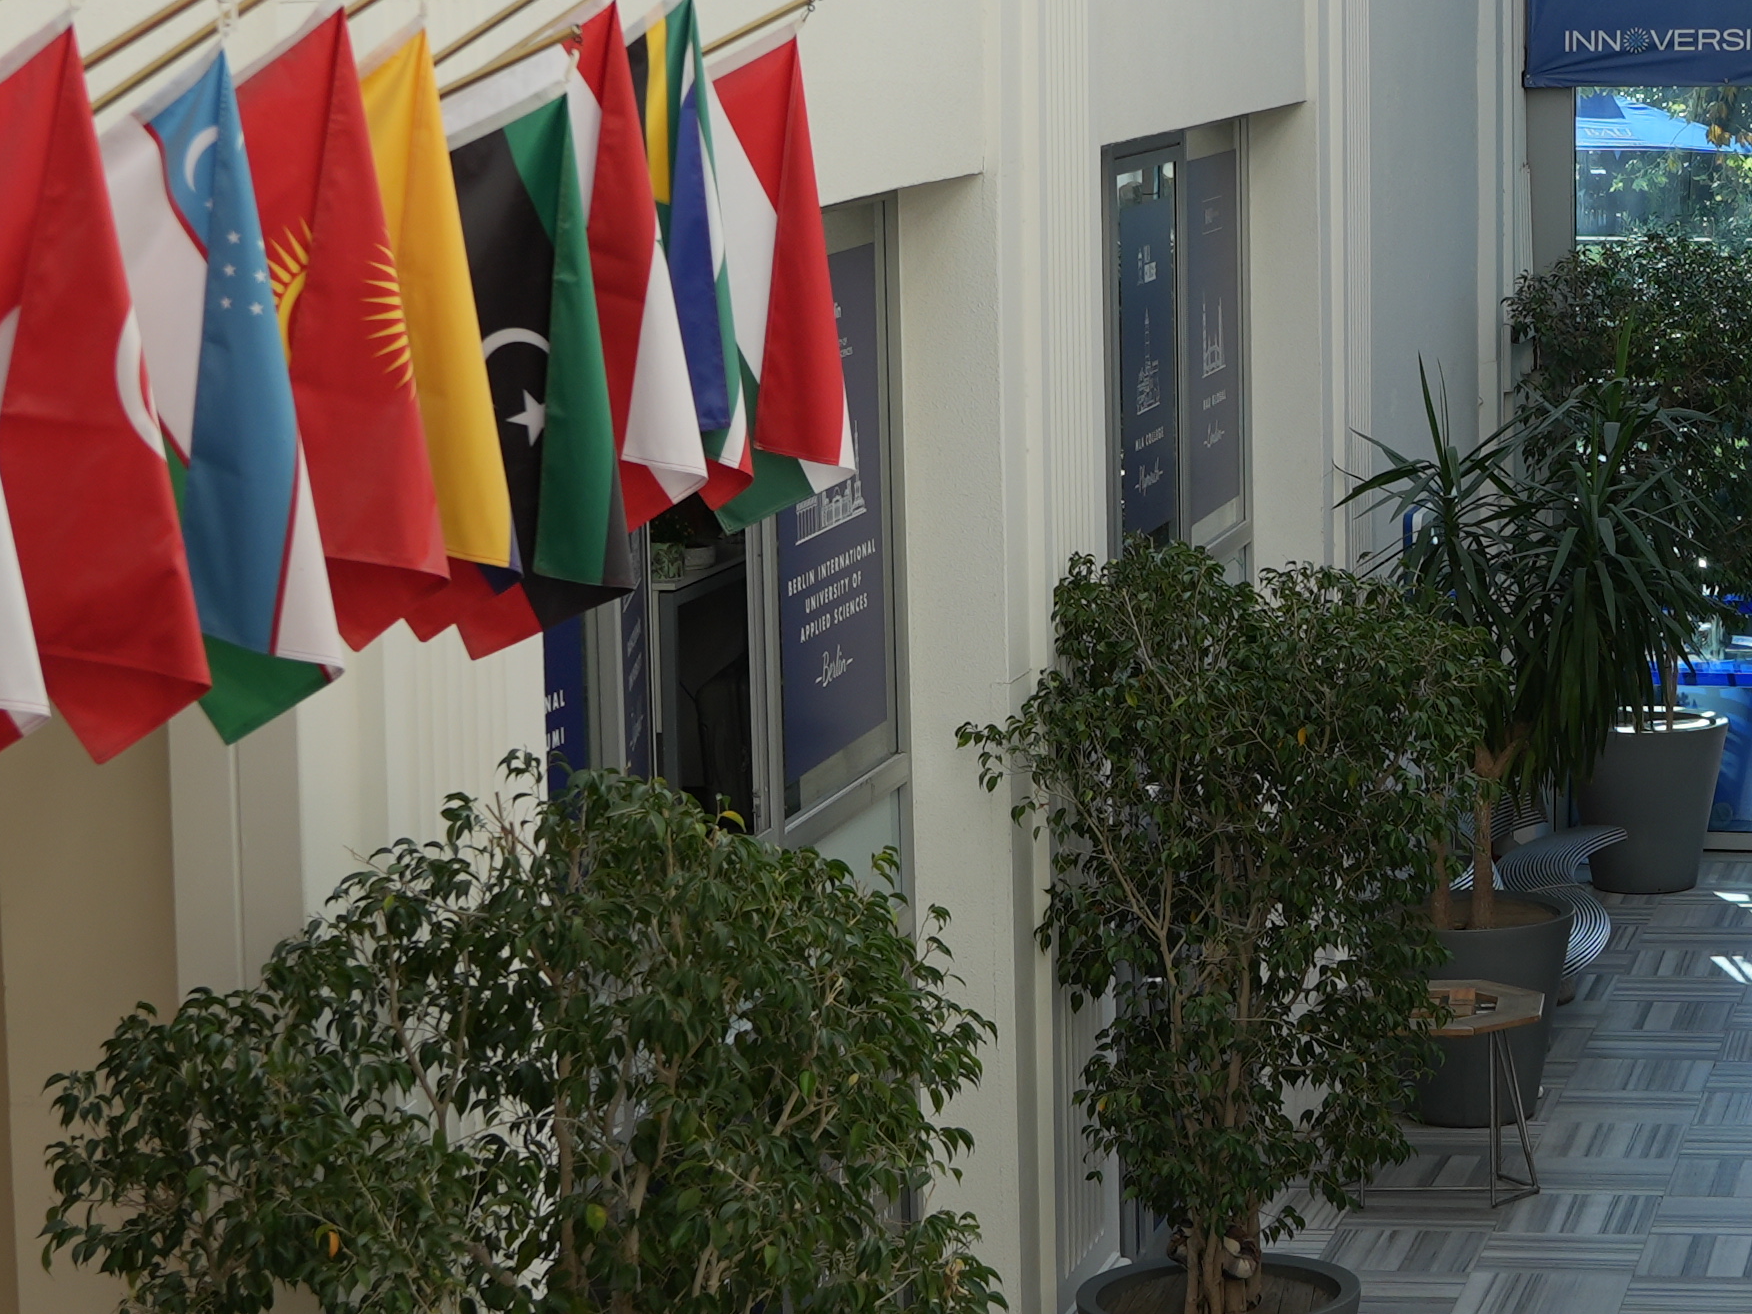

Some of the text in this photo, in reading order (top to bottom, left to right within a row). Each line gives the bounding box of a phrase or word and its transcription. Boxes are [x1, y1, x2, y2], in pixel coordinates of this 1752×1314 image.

[788, 537, 877, 597] BERLIN INTERNATIONAL
[804, 570, 863, 615] UNIVERSITY OF
[799, 591, 869, 645] APPLIED SCIENCES
